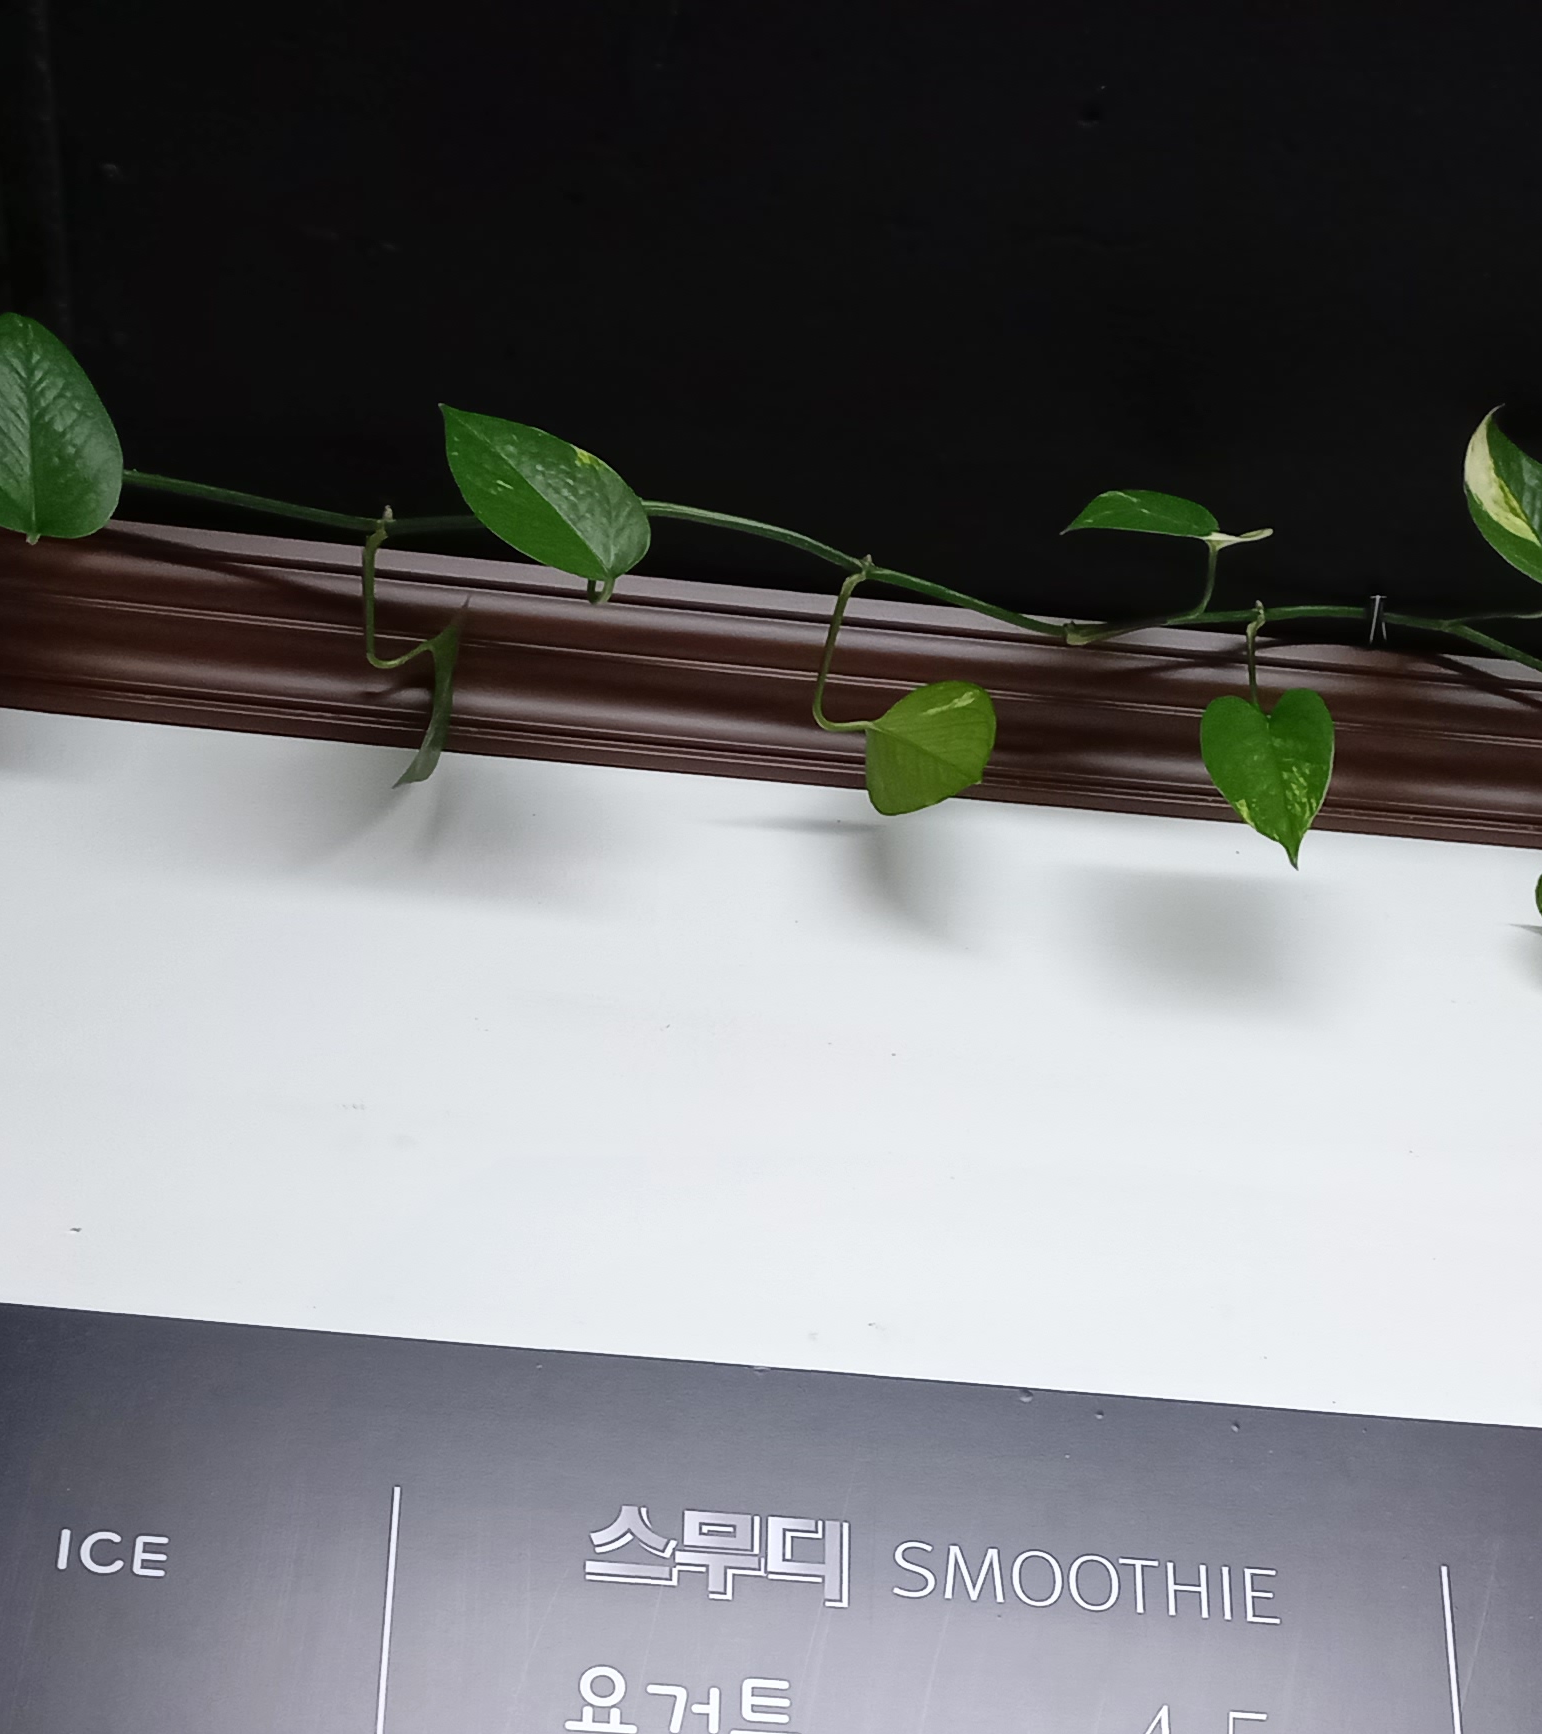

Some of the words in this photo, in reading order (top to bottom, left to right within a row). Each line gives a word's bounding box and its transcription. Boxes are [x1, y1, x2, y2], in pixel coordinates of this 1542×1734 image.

[56, 1527, 170, 1578] ICE
[584, 1504, 850, 1609] 스무디
[891, 1540, 1282, 1625] SMOOTHIE
